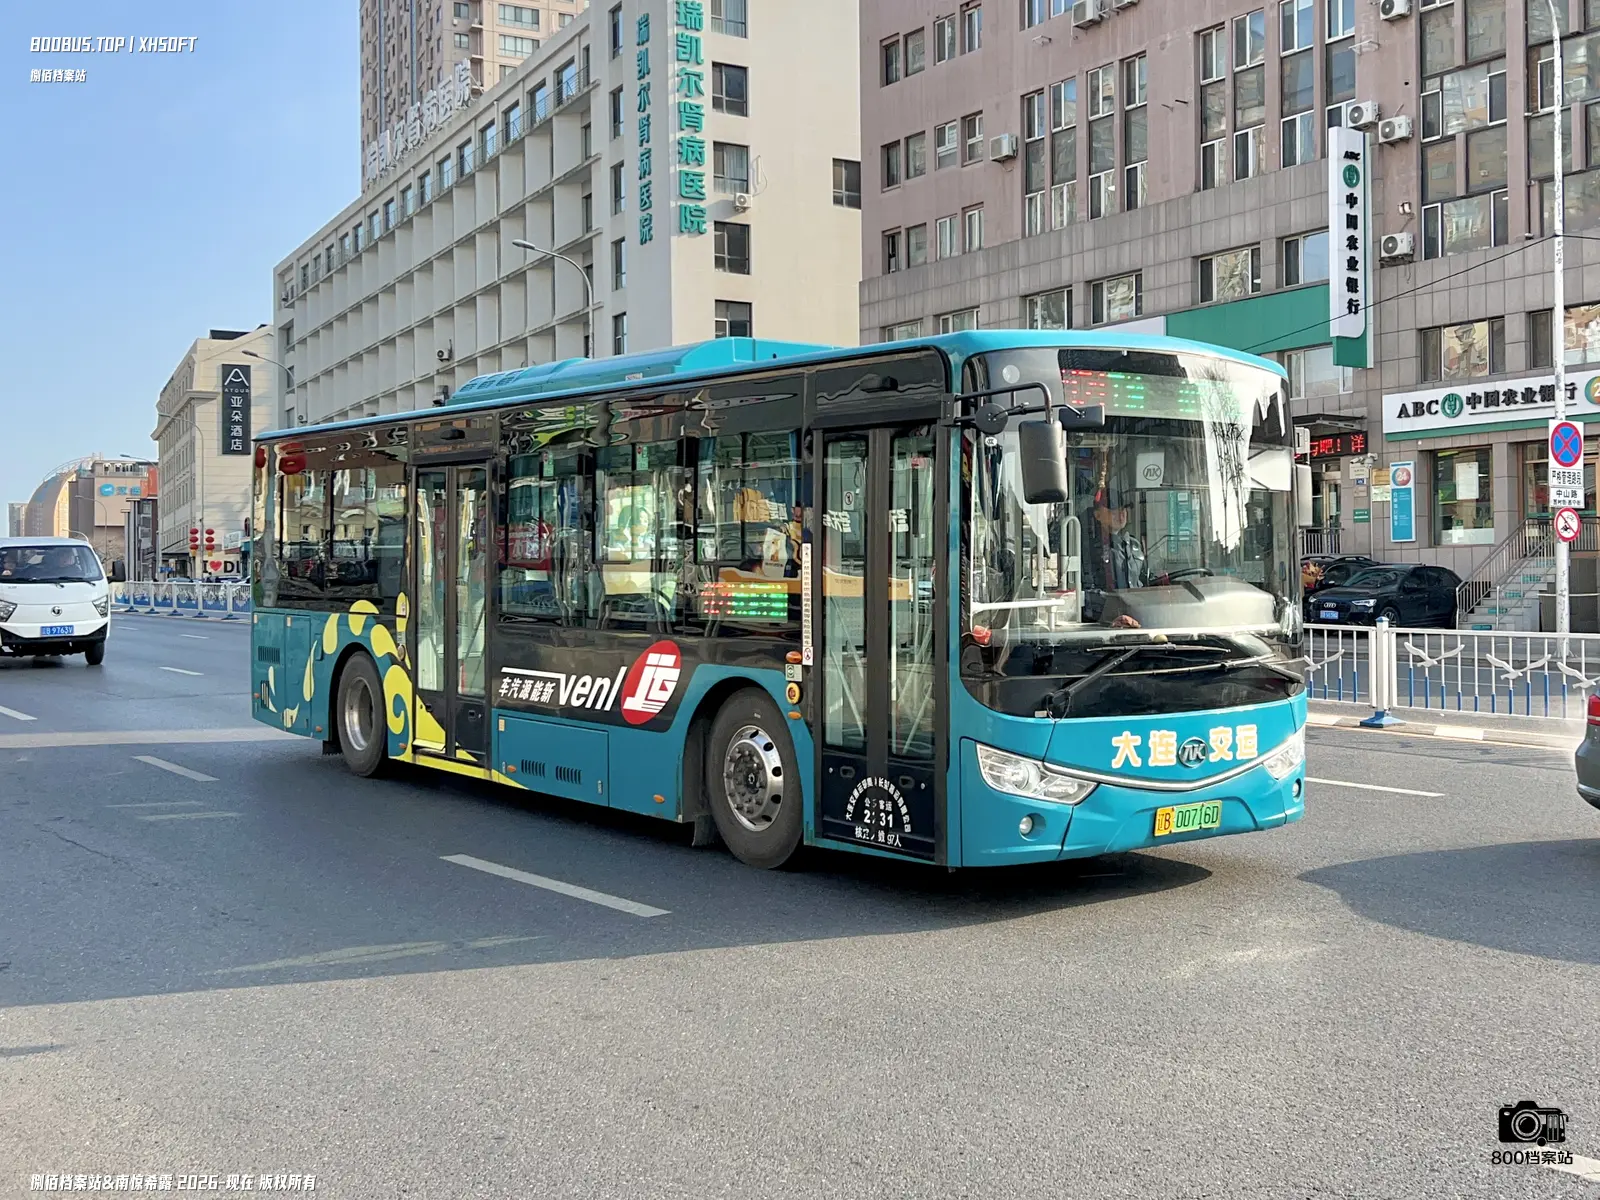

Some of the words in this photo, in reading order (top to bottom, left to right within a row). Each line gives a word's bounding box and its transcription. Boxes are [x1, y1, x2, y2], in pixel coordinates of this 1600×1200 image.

[635, 12, 654, 246] 瑞凯尔肾病医院
[676, 0, 707, 235] 瑞凯尔肾病医院
[1345, 192, 1360, 316] 中国农业银行
[1397, 399, 1440, 419] ABC
[1466, 382, 1578, 410] 中国农业银行
[230, 395, 243, 451] 亚朵酒店
[1556, 490, 1578, 498] 中山路
[1111, 729, 1178, 769] 大连
[1209, 724, 1258, 763] 交运
